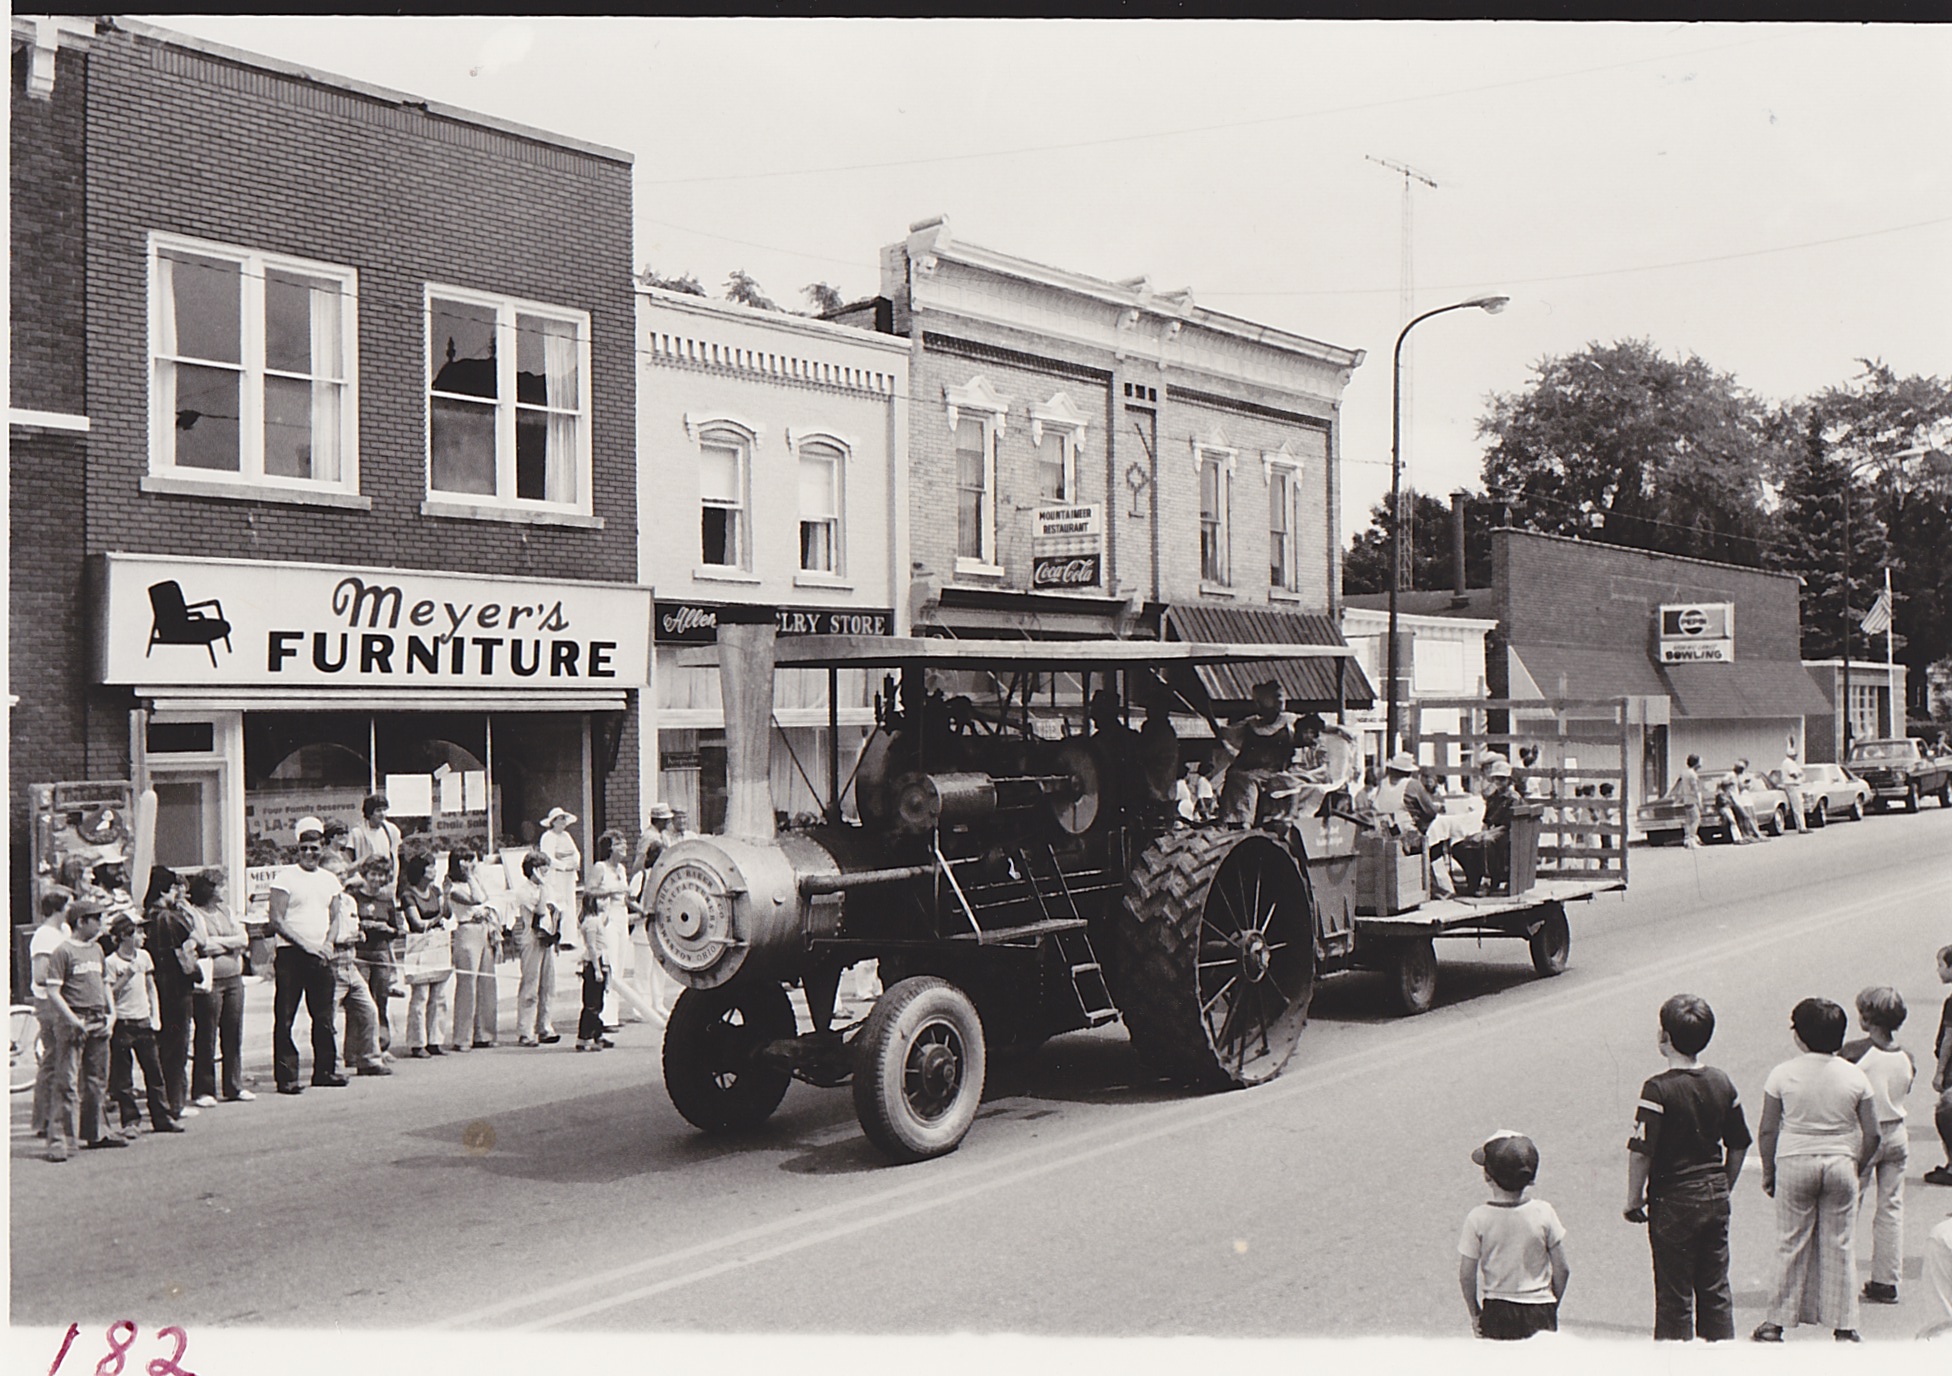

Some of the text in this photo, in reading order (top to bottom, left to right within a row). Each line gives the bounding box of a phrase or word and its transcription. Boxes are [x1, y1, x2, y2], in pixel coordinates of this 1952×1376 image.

[1039, 508, 1092, 520] MOUNTAINEER
[1043, 522, 1089, 534] RESTAURANT
[1035, 558, 1095, 583] Coca-Cola
[333, 577, 569, 644] Meyer's
[829, 615, 886, 635] STORE
[267, 631, 618, 677] FURNITURE
[1665, 650, 1722, 661] BOWLING
[285, 804, 314, 815] Family
[316, 802, 356, 812] Deserves
[436, 817, 488, 830] Chair Sale
[685, 869, 713, 889] BAKER
[666, 882, 716, 930] MANUFACTURERS
[660, 923, 717, 961] SWANTON OHIO
[48, 1320, 197, 1376] 182
